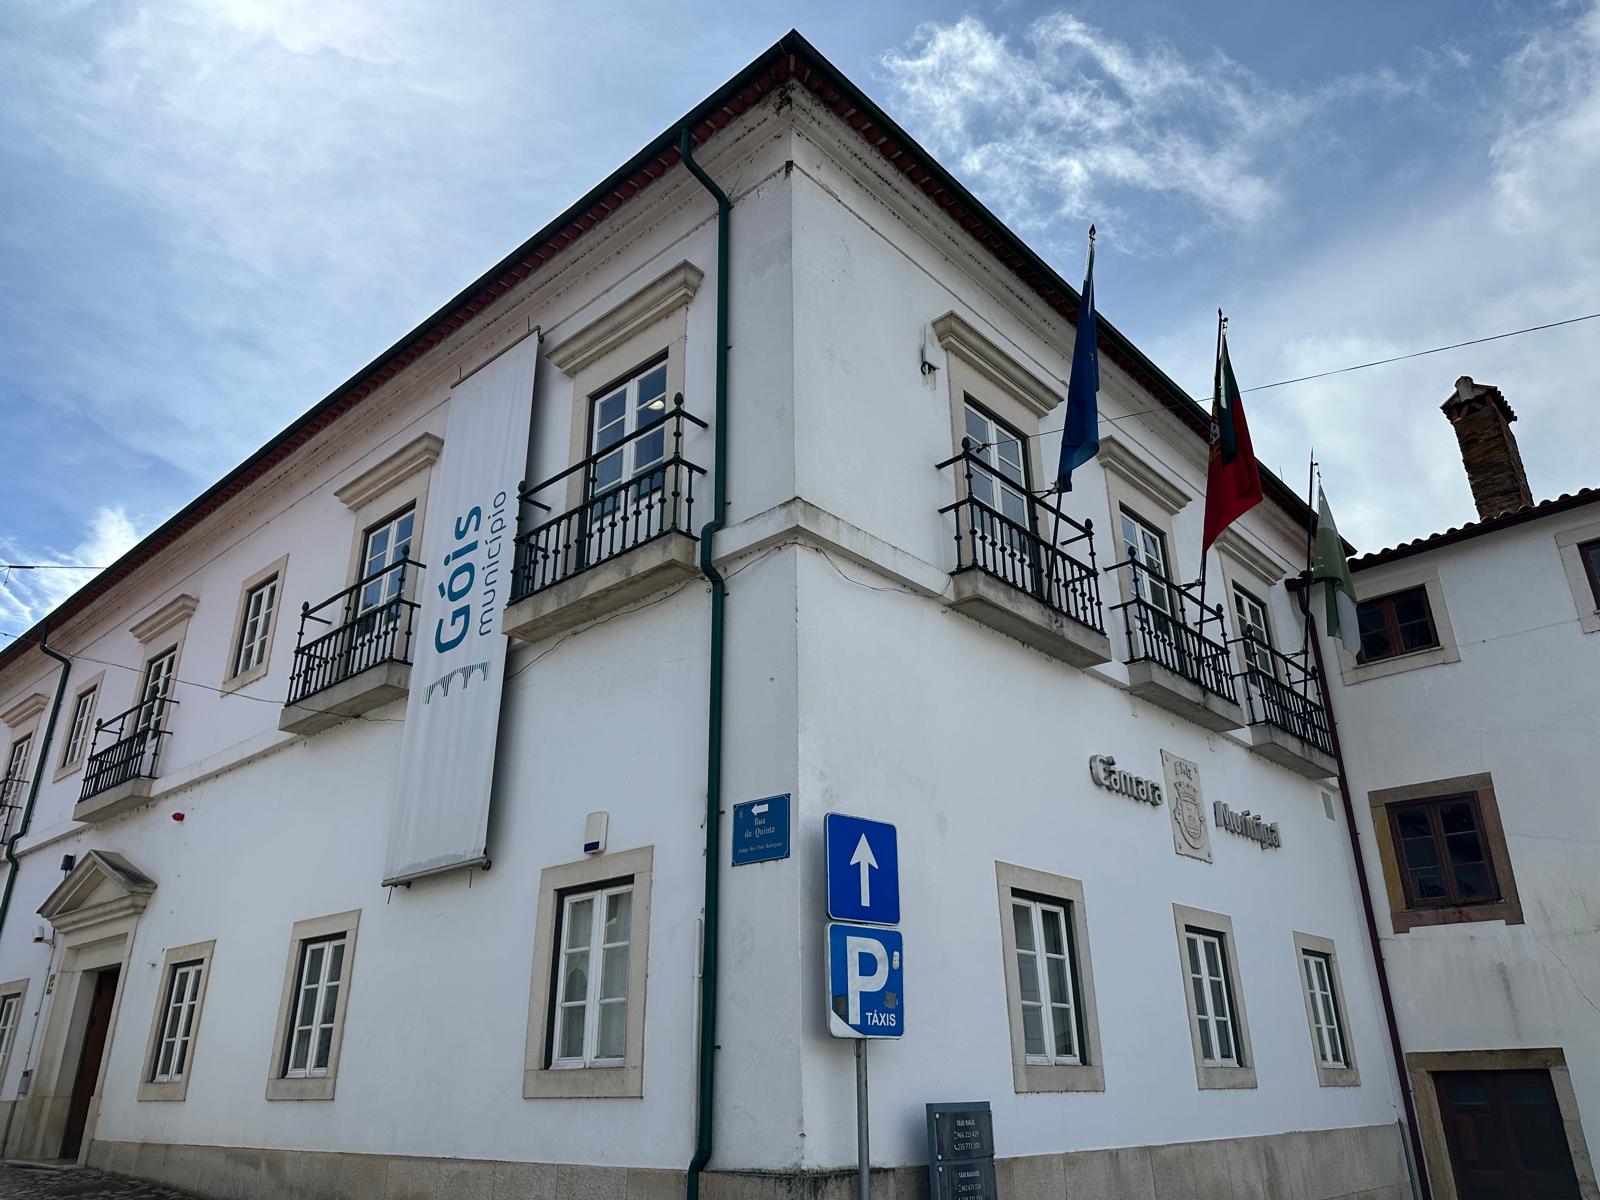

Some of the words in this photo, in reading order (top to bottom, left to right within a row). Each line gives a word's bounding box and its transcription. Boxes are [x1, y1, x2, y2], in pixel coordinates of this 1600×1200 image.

[434, 505, 482, 654] Góis
[478, 490, 507, 636] município
[1089, 754, 1164, 806] Câmara
[744, 829, 752, 838] da
[754, 826, 776, 838] Quinta
[754, 817, 766, 826] Rua
[846, 935, 889, 1025] P
[865, 1009, 896, 1027] TÁXIS
